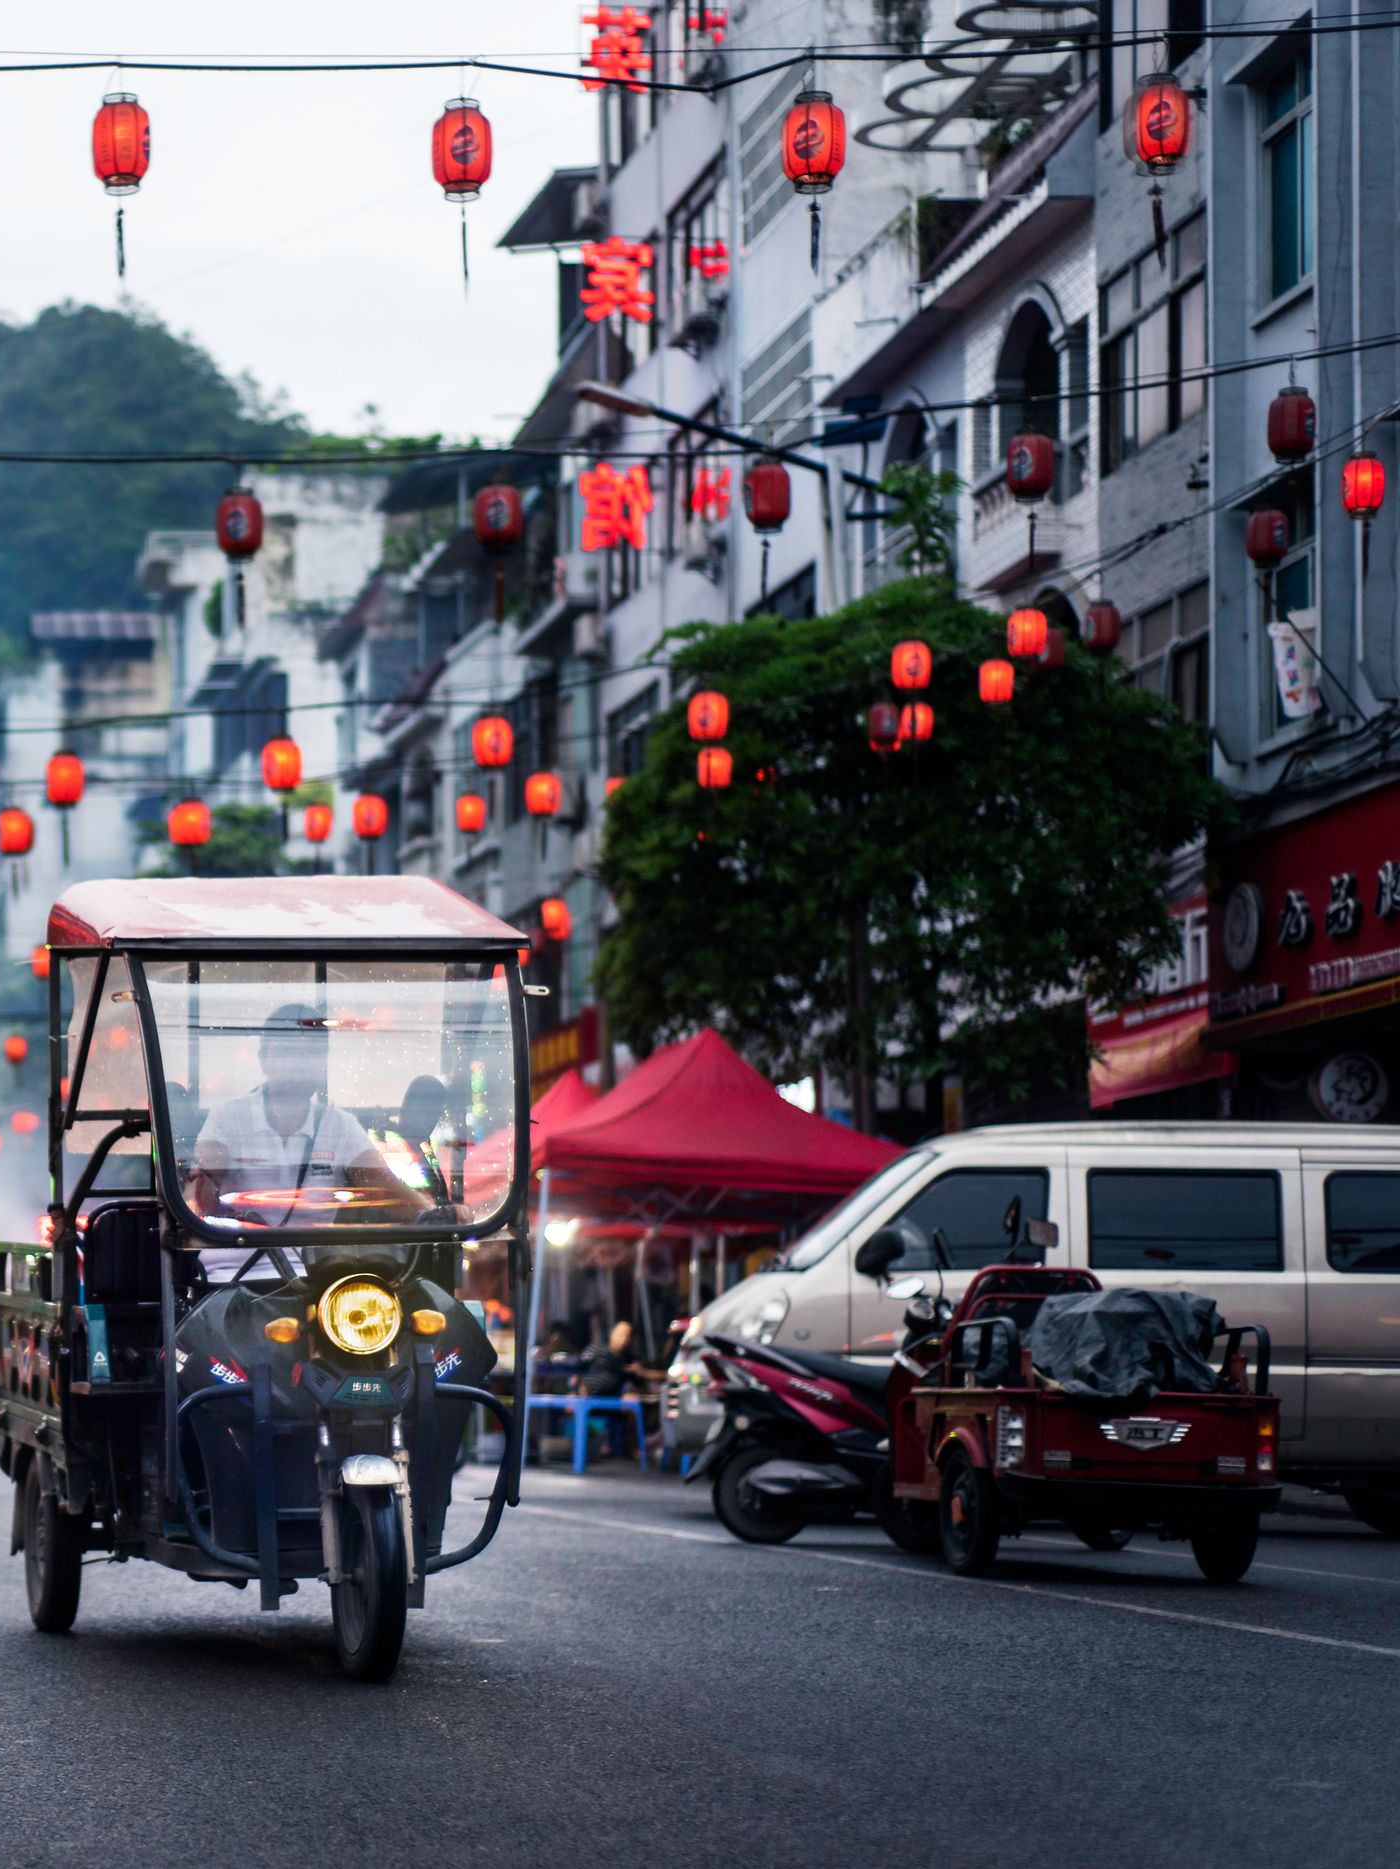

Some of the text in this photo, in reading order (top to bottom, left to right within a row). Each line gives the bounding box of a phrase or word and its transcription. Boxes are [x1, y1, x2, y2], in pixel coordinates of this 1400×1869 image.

[210, 1362, 245, 1384] 步步
[352, 1382, 382, 1393] 步步先
